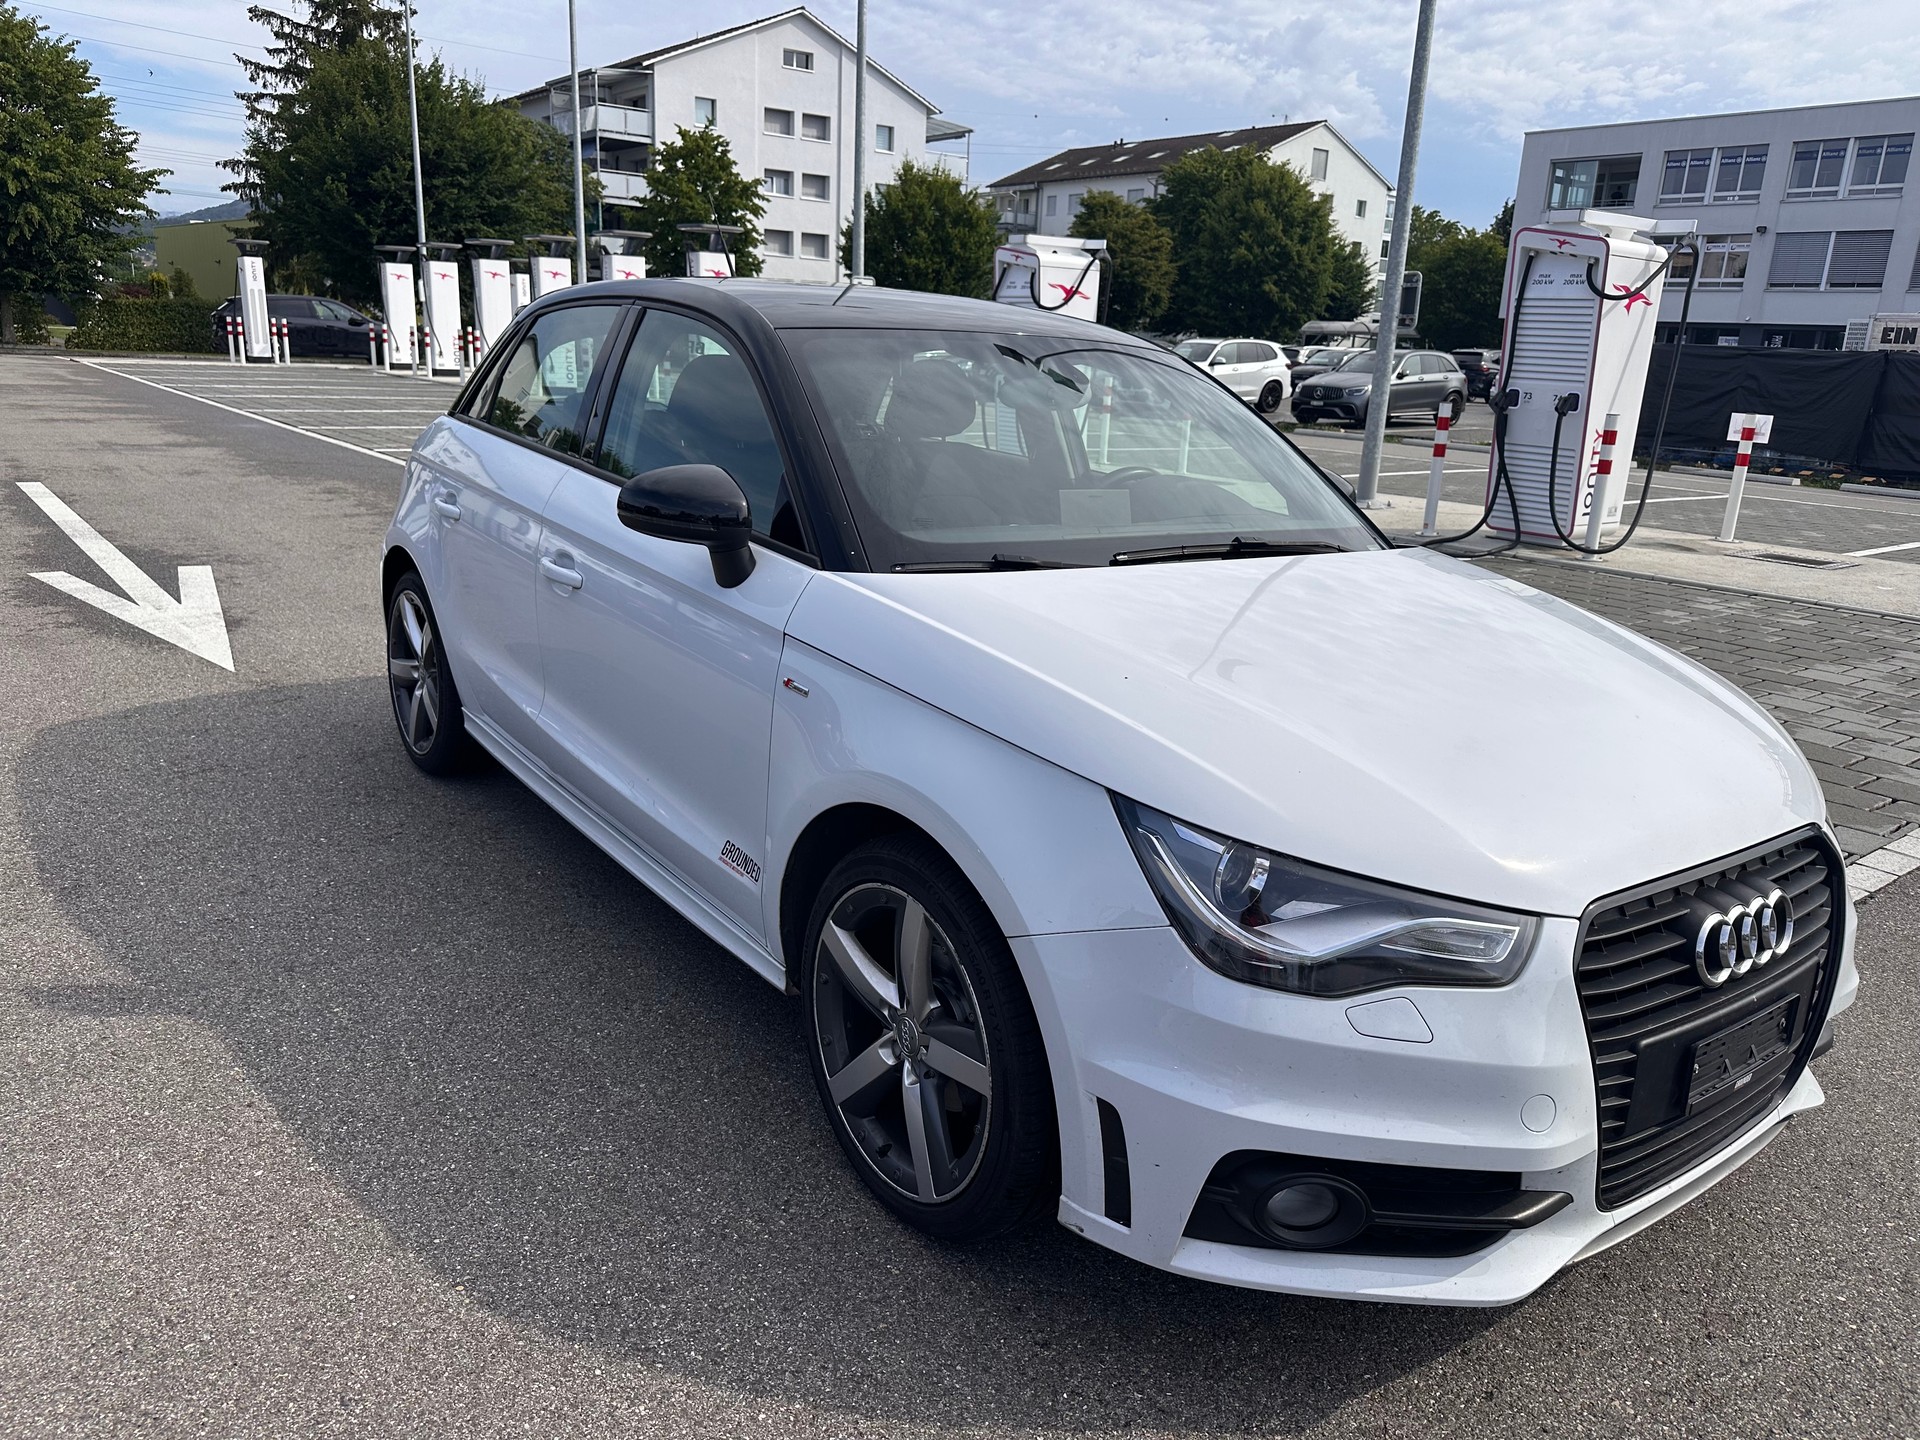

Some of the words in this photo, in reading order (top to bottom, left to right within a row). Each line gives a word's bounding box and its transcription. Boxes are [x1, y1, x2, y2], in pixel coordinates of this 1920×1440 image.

[1880, 326, 1918, 344] EIN
[1523, 392, 1533, 400] 73
[721, 839, 761, 883] GROUNDED
